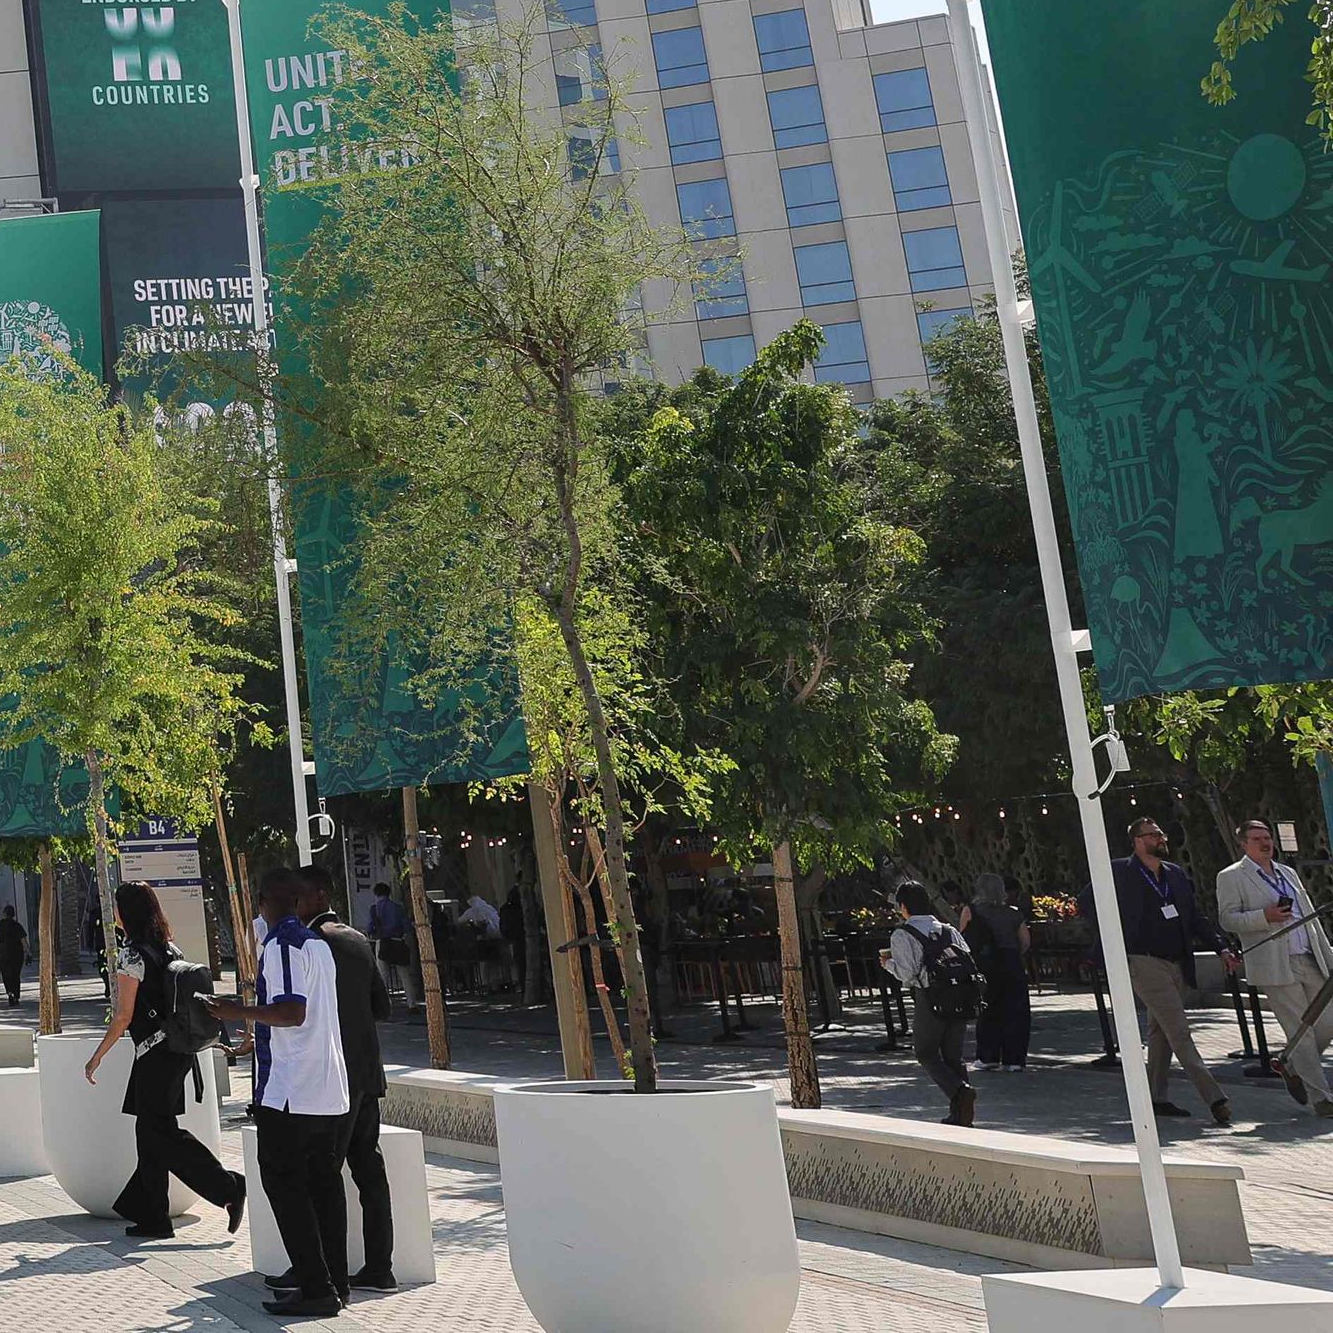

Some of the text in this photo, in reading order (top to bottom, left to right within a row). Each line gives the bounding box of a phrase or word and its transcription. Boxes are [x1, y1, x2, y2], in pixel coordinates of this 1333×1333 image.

[92, 84, 210, 105] COUNTRIES
[134, 278, 214, 301] SETTING
[150, 305, 189, 327] FOR
[148, 820, 166, 835] B4
